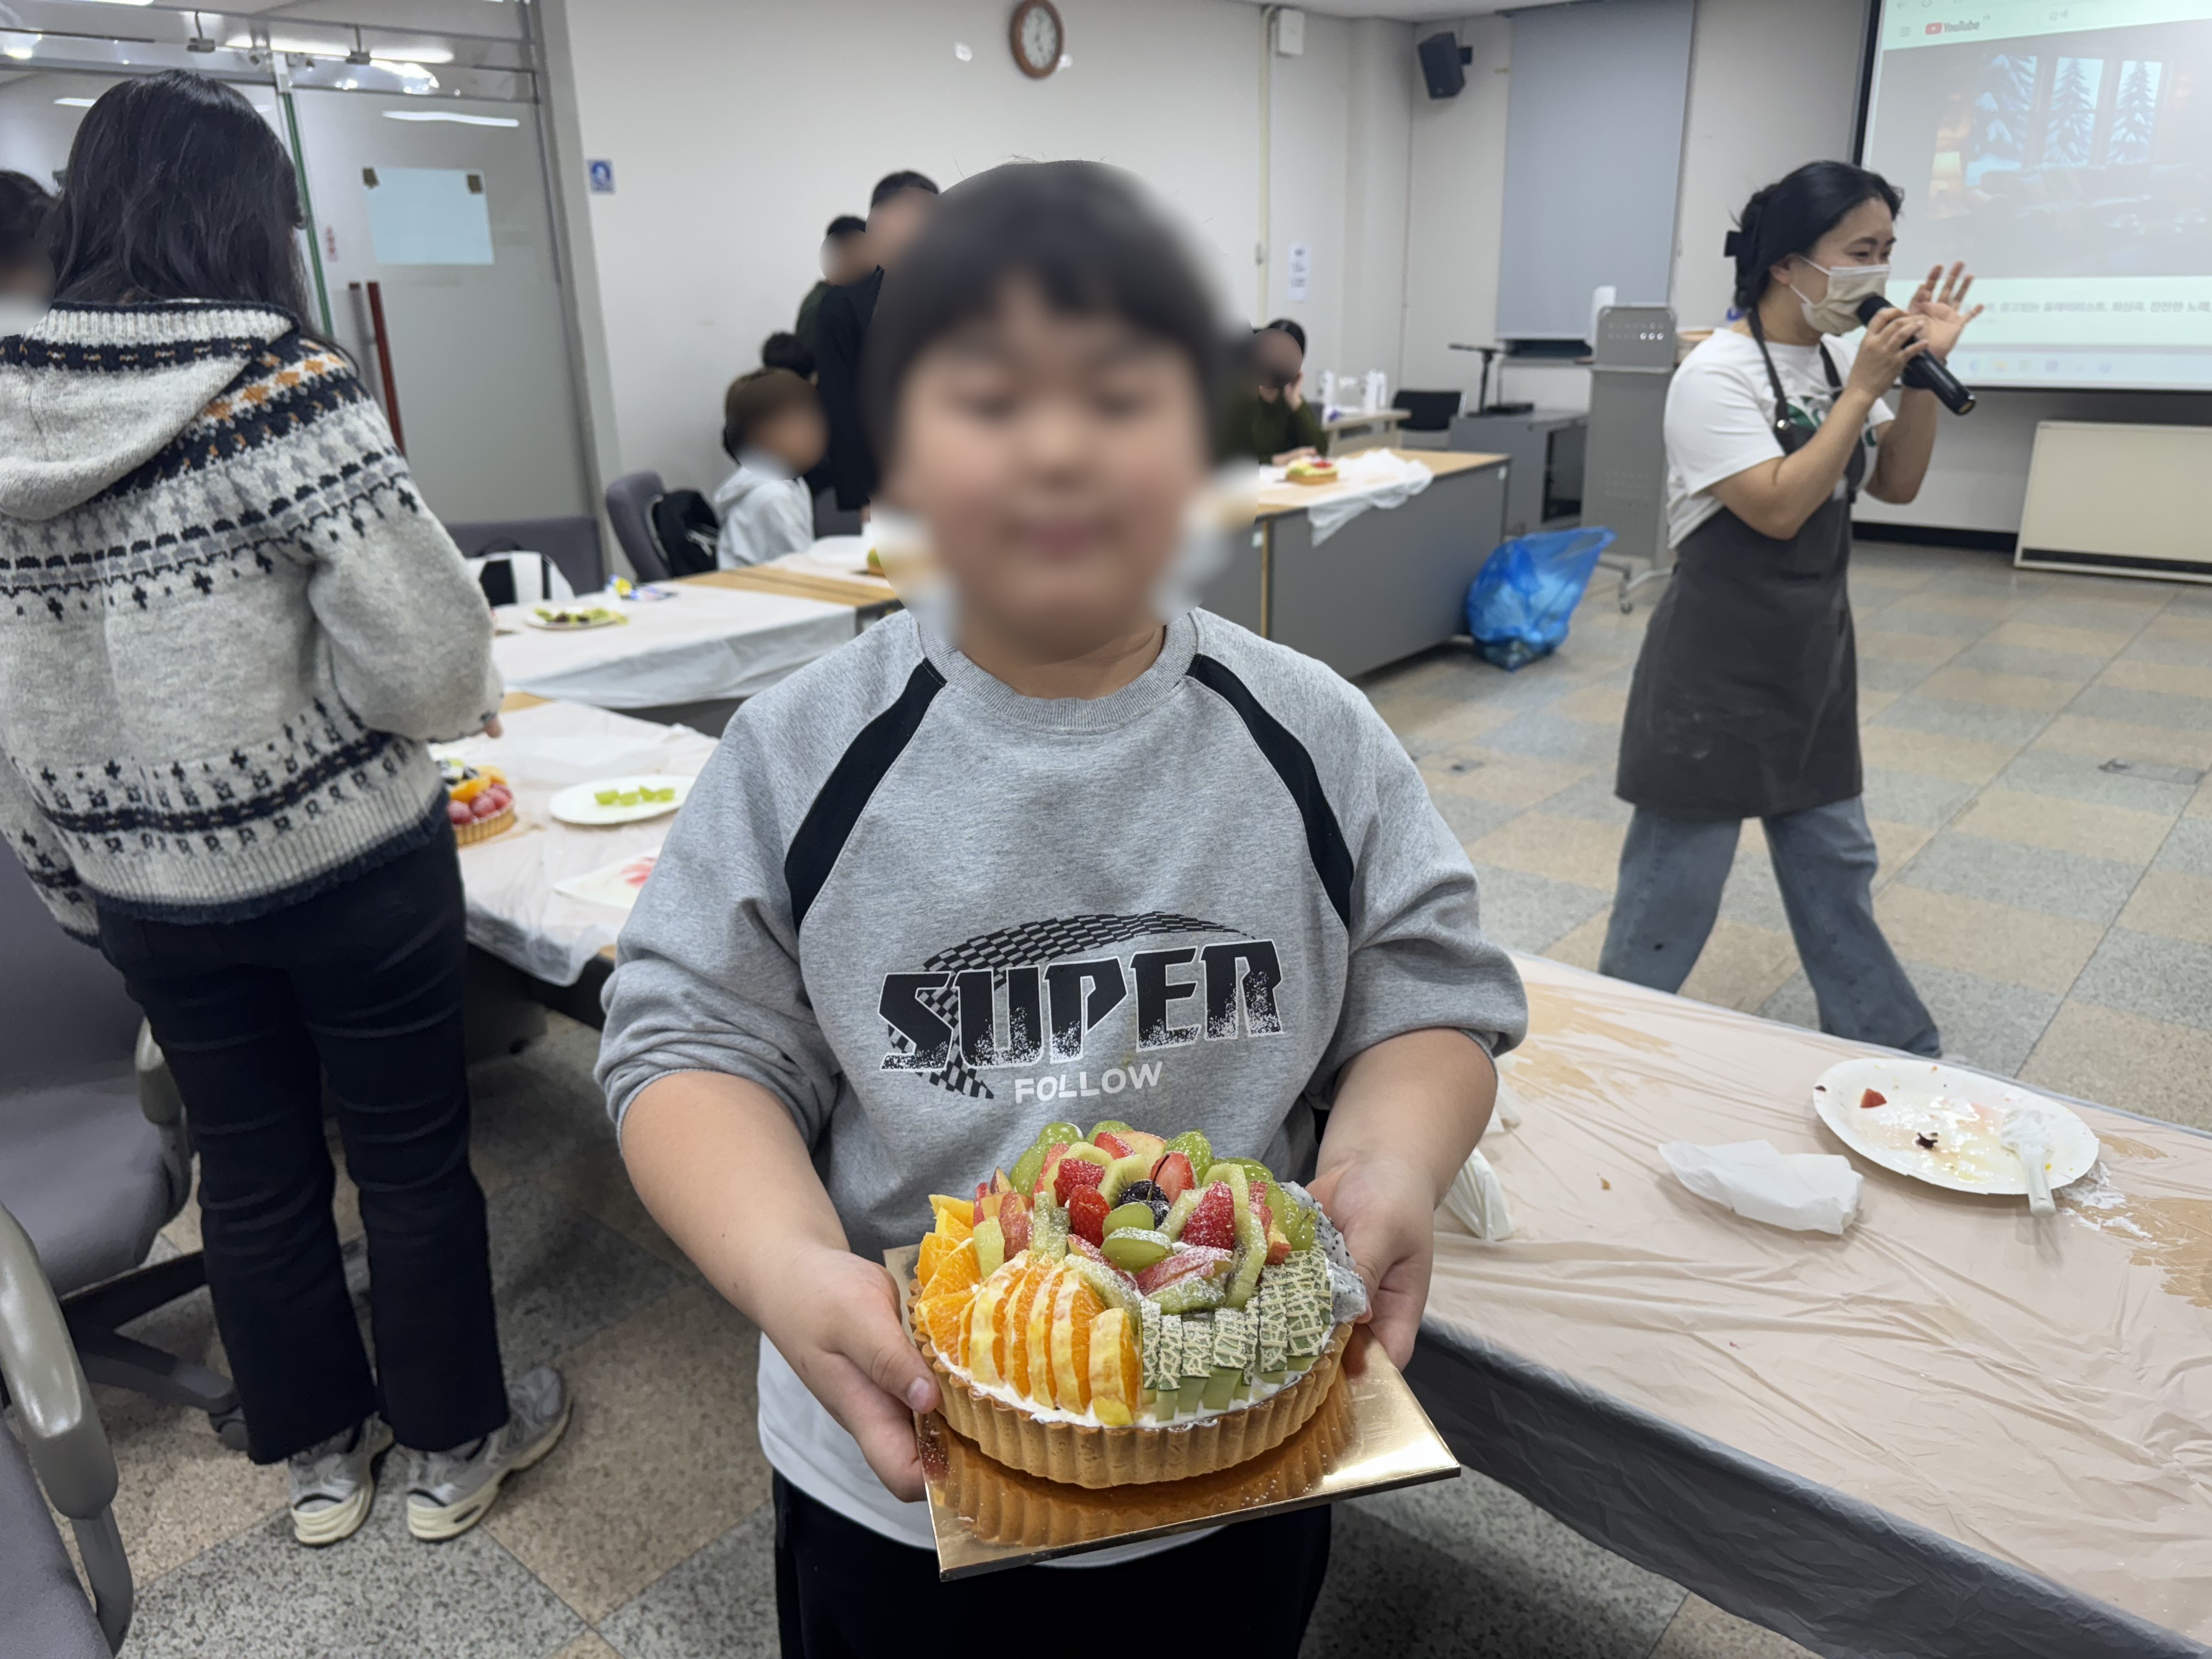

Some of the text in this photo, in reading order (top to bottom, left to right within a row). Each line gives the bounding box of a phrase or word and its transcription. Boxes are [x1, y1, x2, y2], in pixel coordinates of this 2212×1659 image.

[1944, 20, 1980, 33] YouTube
[878, 939, 1284, 1071] SUPER
[1014, 1061, 1164, 1104] FOLLOW
